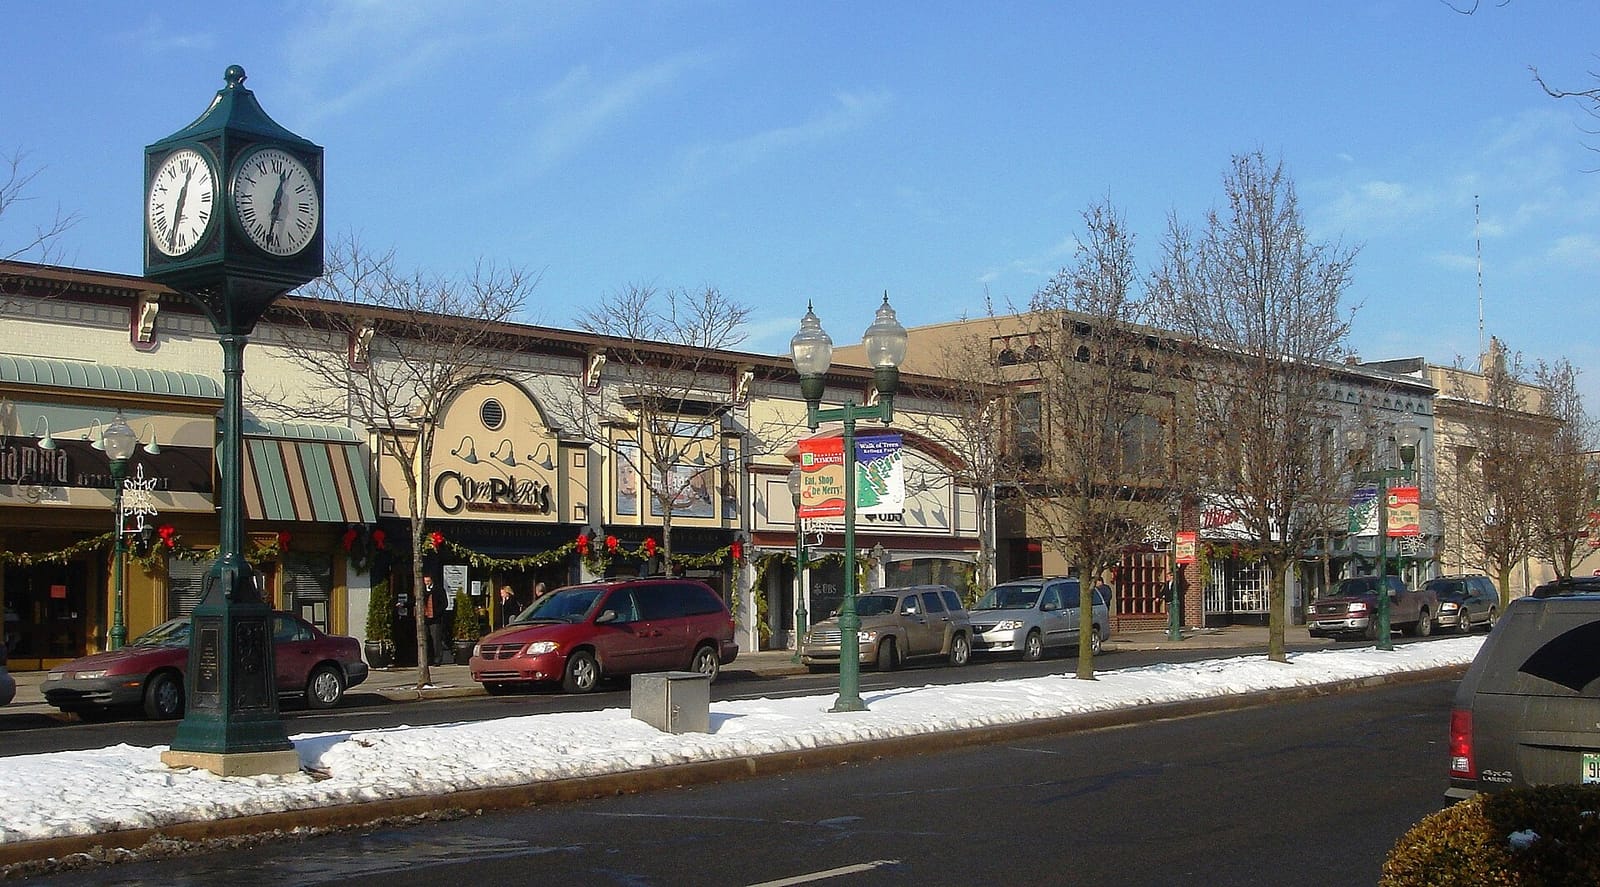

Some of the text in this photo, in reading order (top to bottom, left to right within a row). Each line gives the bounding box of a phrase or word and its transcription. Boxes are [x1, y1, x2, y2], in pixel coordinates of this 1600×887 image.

[180, 160, 189, 174] XII
[256, 161, 267, 177] XI
[271, 160, 282, 174] XII
[167, 166, 177, 182] XI
[199, 174, 208, 185] II
[244, 174, 256, 187] X
[295, 185, 306, 194] II
[201, 192, 210, 202] III
[241, 192, 252, 205] IX
[299, 203, 310, 214] III
[243, 208, 256, 228] VIII
[296, 218, 307, 233] IV
[814, 456, 842, 464] PLYMOUTH
[805, 475, 834, 486] Eat, Shop
[812, 486, 821, 495] be
[822, 485, 843, 496] Merry!
[822, 583, 837, 594] UBS
